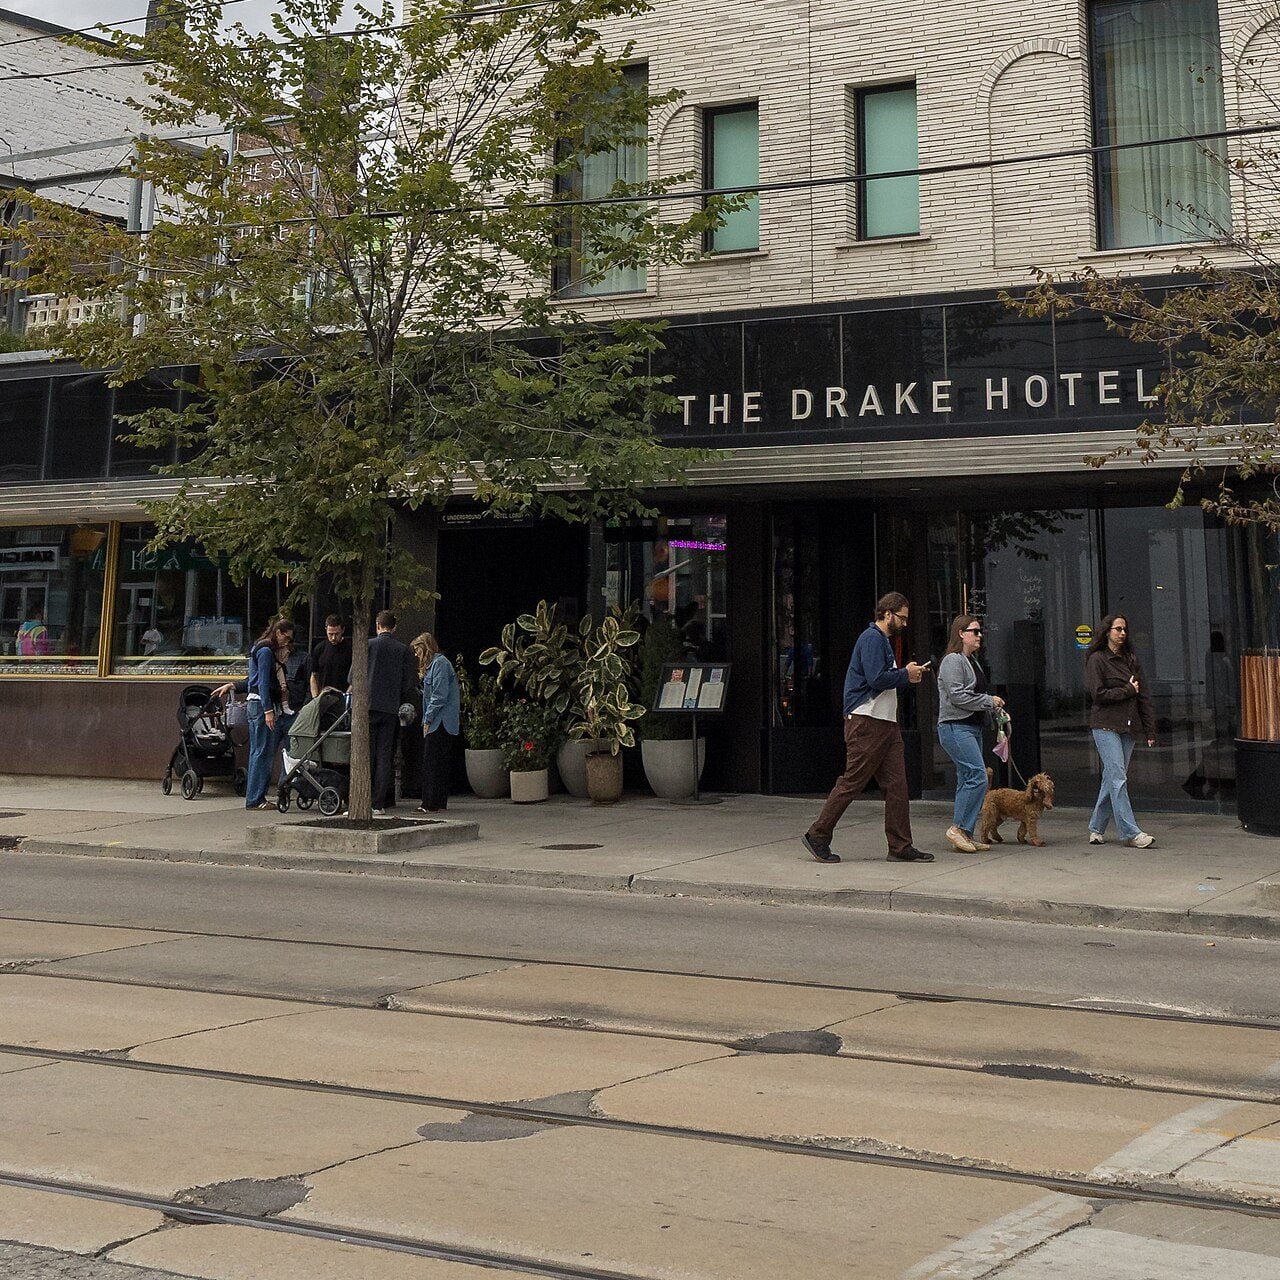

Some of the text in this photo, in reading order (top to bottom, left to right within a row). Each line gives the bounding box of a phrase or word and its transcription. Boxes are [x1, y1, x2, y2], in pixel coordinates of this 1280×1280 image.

[678, 368, 1159, 426] THE DRAKE HOTEL
